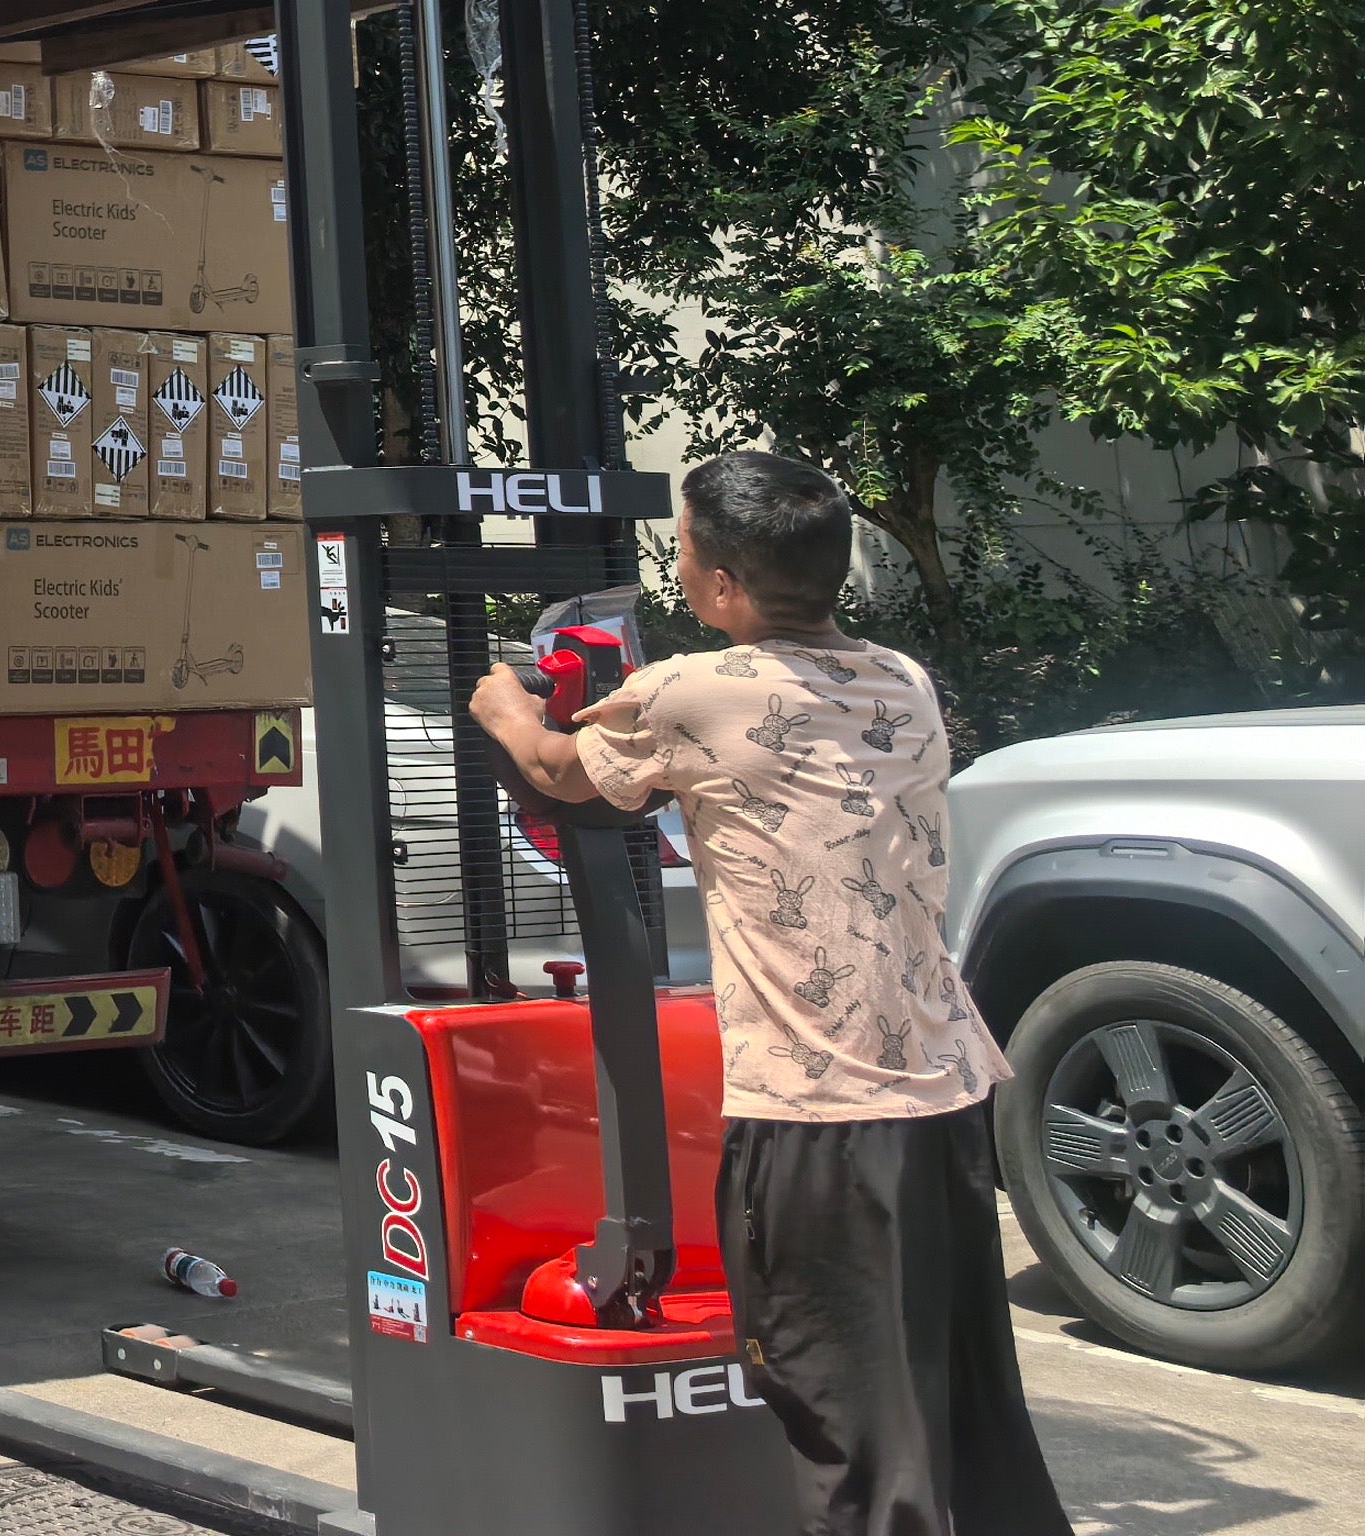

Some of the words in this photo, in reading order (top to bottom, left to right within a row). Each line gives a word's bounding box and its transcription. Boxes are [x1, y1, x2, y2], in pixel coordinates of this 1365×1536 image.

[53, 157, 155, 177] ELECTRONICS
[52, 199, 103, 218] Electric
[107, 202, 140, 221] Kids'
[52, 221, 107, 241] Scooter
[456, 471, 603, 513] HELI
[35, 534, 139, 549] ELECTRONICS
[34, 578, 86, 597] Electric
[89, 578, 123, 597] Kids'
[34, 602, 90, 620] Scooter
[65, 726, 155, 779] 馬田
[601, 1363, 767, 1423] HEL
